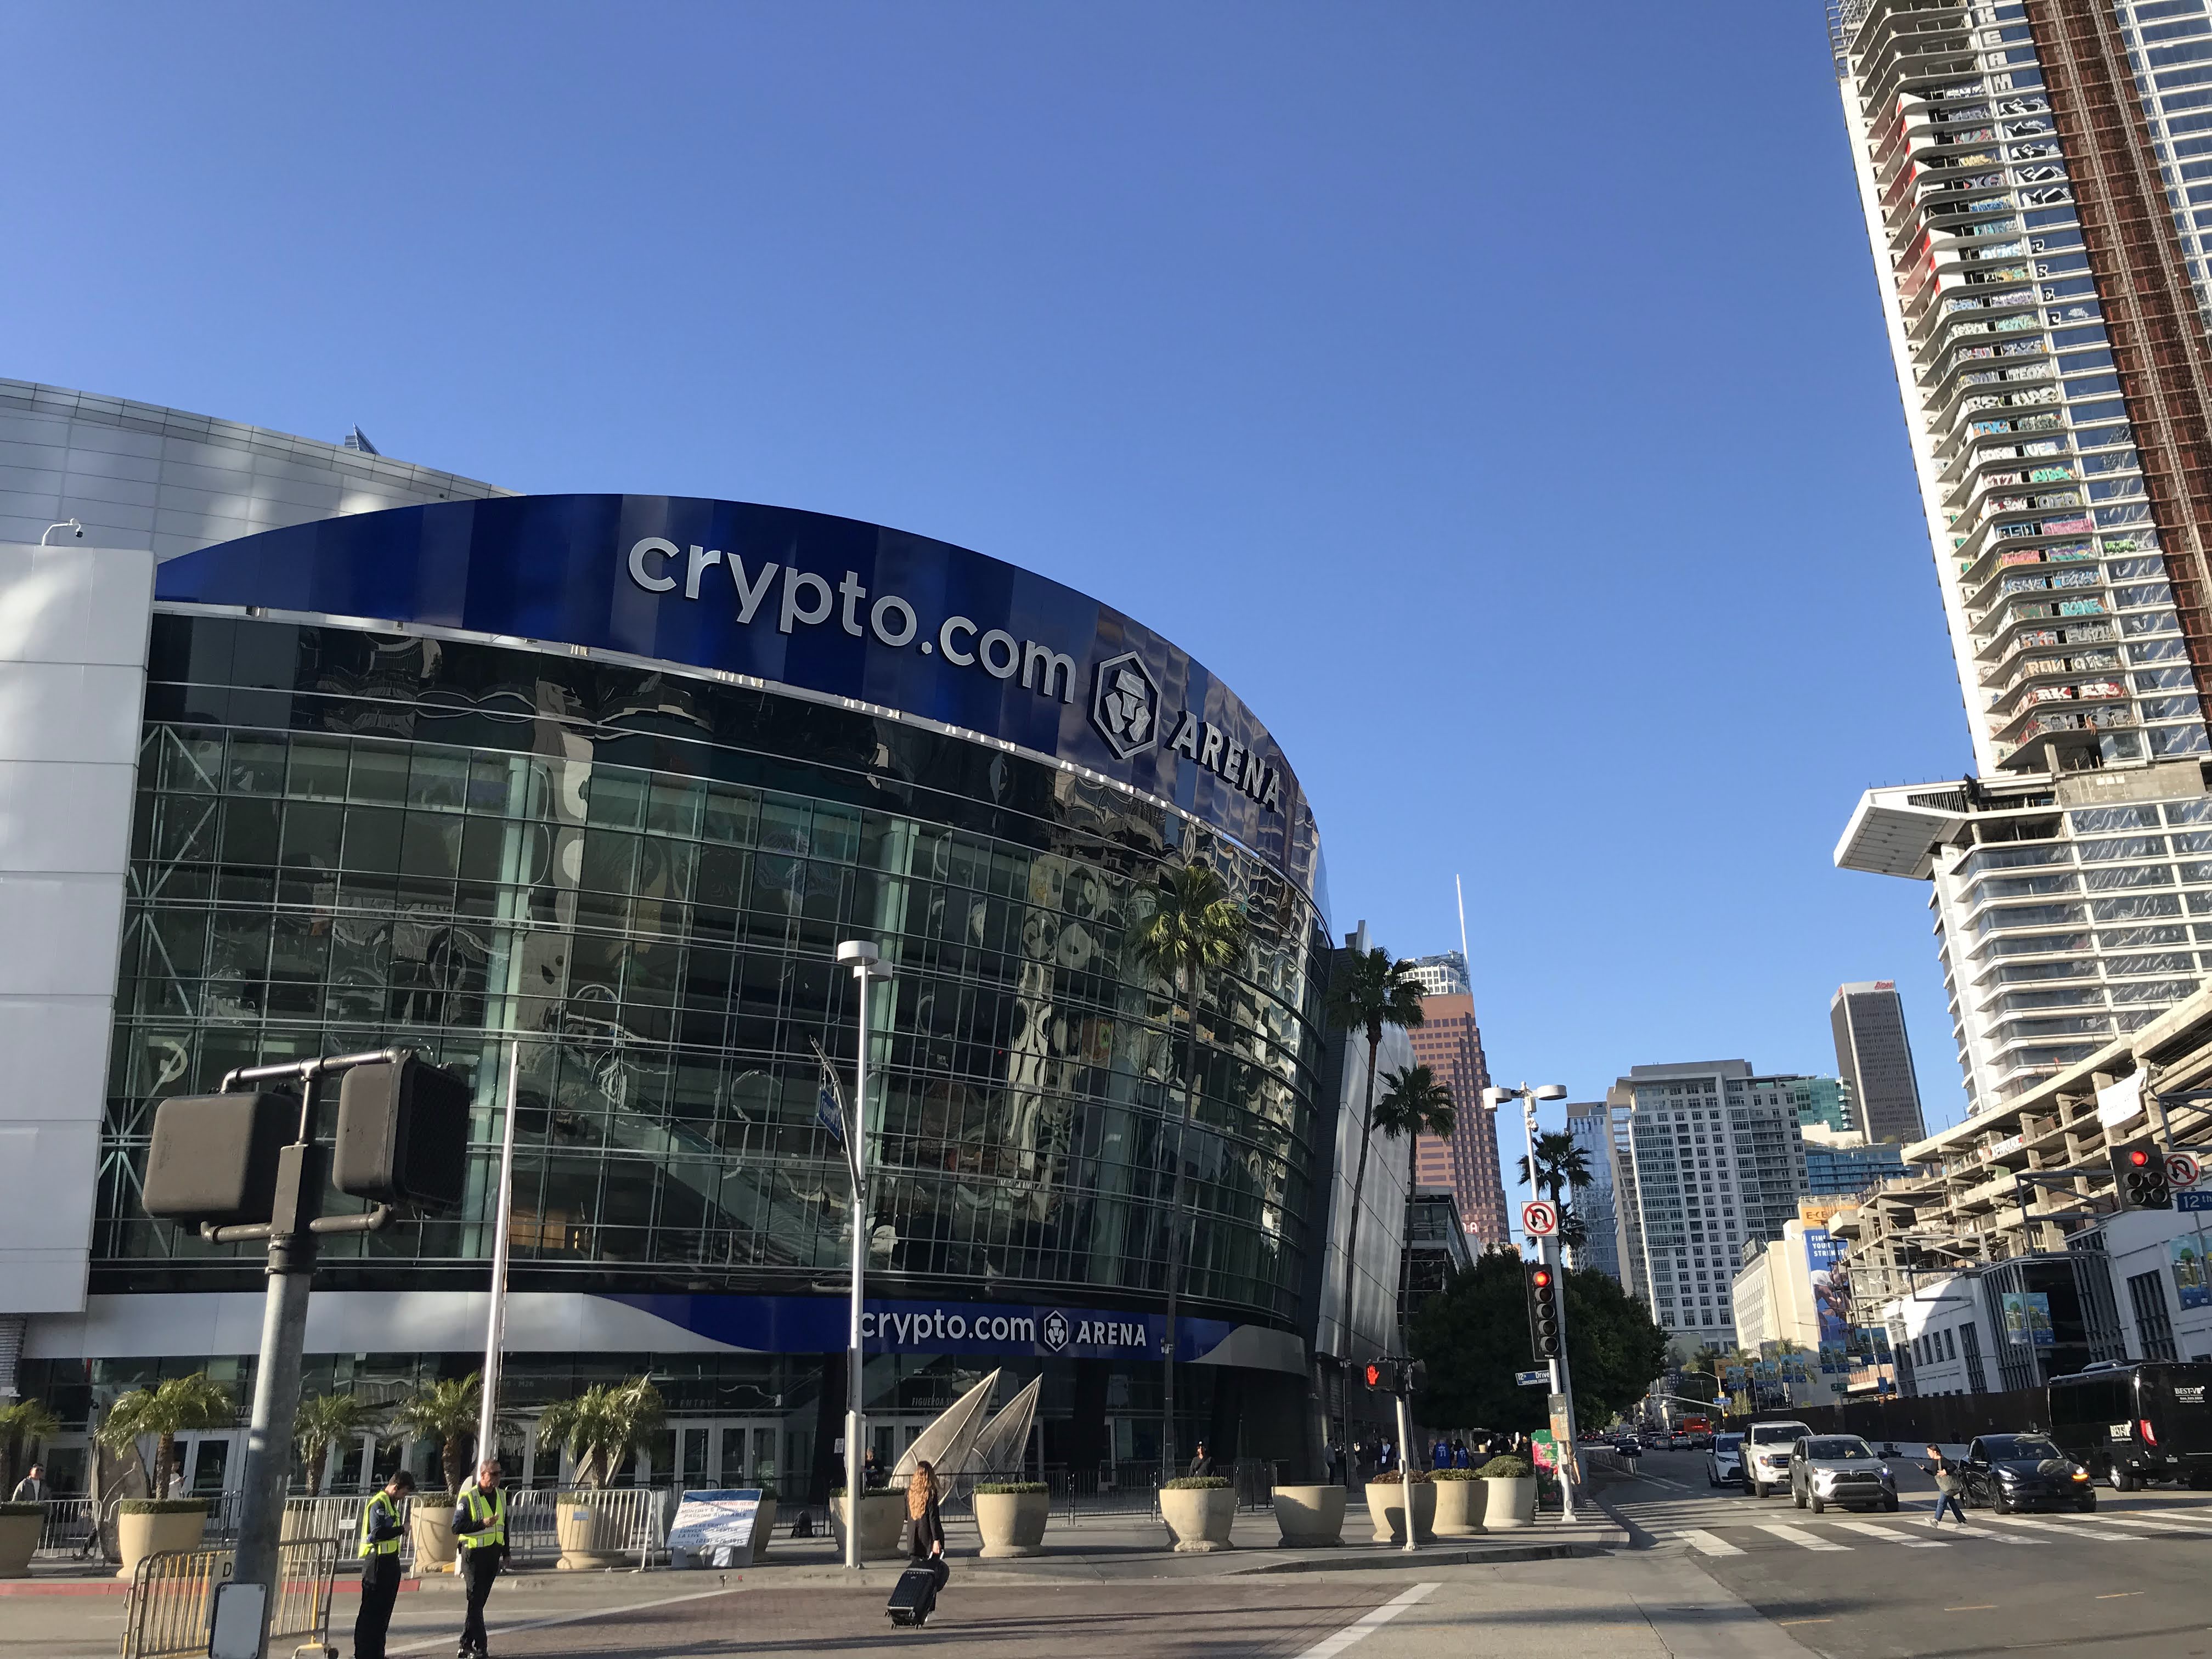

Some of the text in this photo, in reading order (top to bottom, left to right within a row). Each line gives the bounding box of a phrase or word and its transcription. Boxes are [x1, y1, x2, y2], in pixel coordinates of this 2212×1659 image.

[628, 536, 1280, 812] crypto.com ARENA
[862, 1309, 1147, 1347] crypto.com ARENA
[912, 1397, 944, 1406] FIGUEROA
